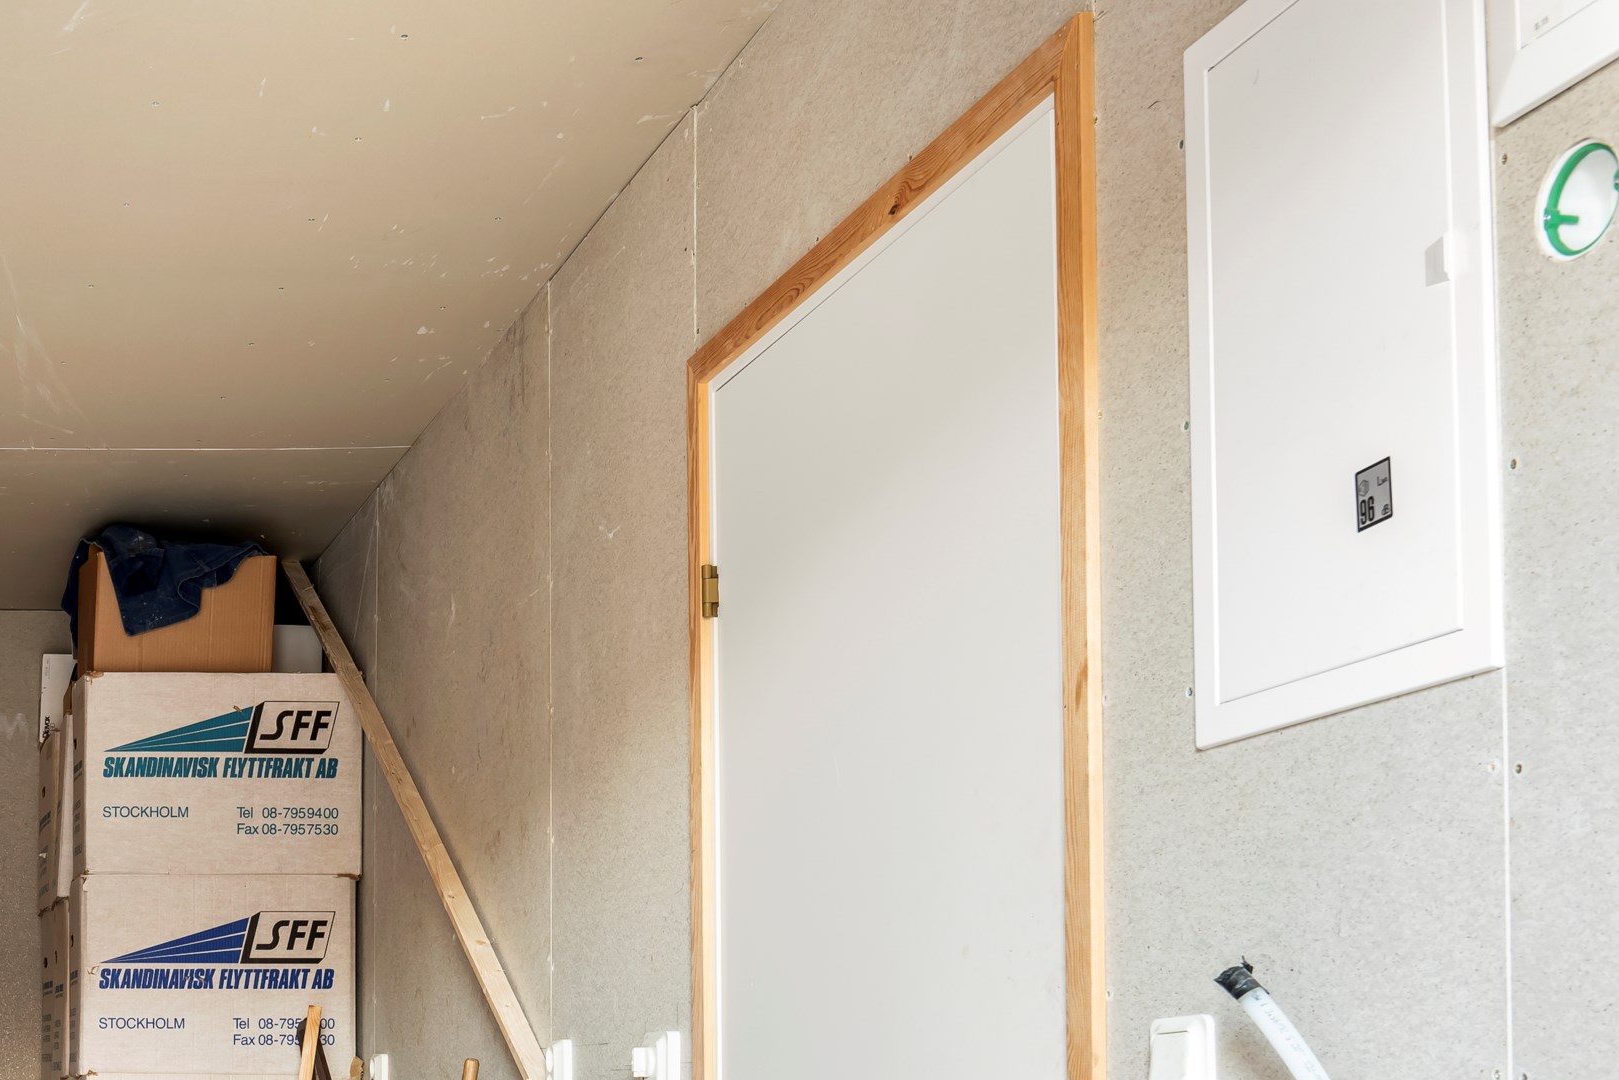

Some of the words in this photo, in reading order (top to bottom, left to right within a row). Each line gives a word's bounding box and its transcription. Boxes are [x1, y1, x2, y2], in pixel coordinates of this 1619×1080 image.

[1360, 495, 1375, 526] 96
[259, 710, 333, 741] SFF
[102, 756, 220, 779] SKANDINAVISK
[222, 757, 315, 779] FLYTTFRAKT
[315, 757, 339, 779] AB
[102, 806, 189, 818] STOCKHOLM
[236, 806, 254, 819] Tel
[261, 807, 339, 819] 08-7959400
[236, 823, 259, 835] Fax
[261, 823, 339, 836] 08-7957530
[255, 920, 328, 950] SFF
[98, 968, 216, 990] SKANDINAVISK
[218, 968, 311, 990] FLYTTFRAKT
[311, 968, 335, 990] AB
[98, 1017, 185, 1030] STOCKHOLM
[233, 1017, 250, 1030] Tel
[258, 1017, 335, 1030] 08-79500
[233, 1034, 255, 1046] Fax
[258, 1034, 335, 1046] 08-79530
